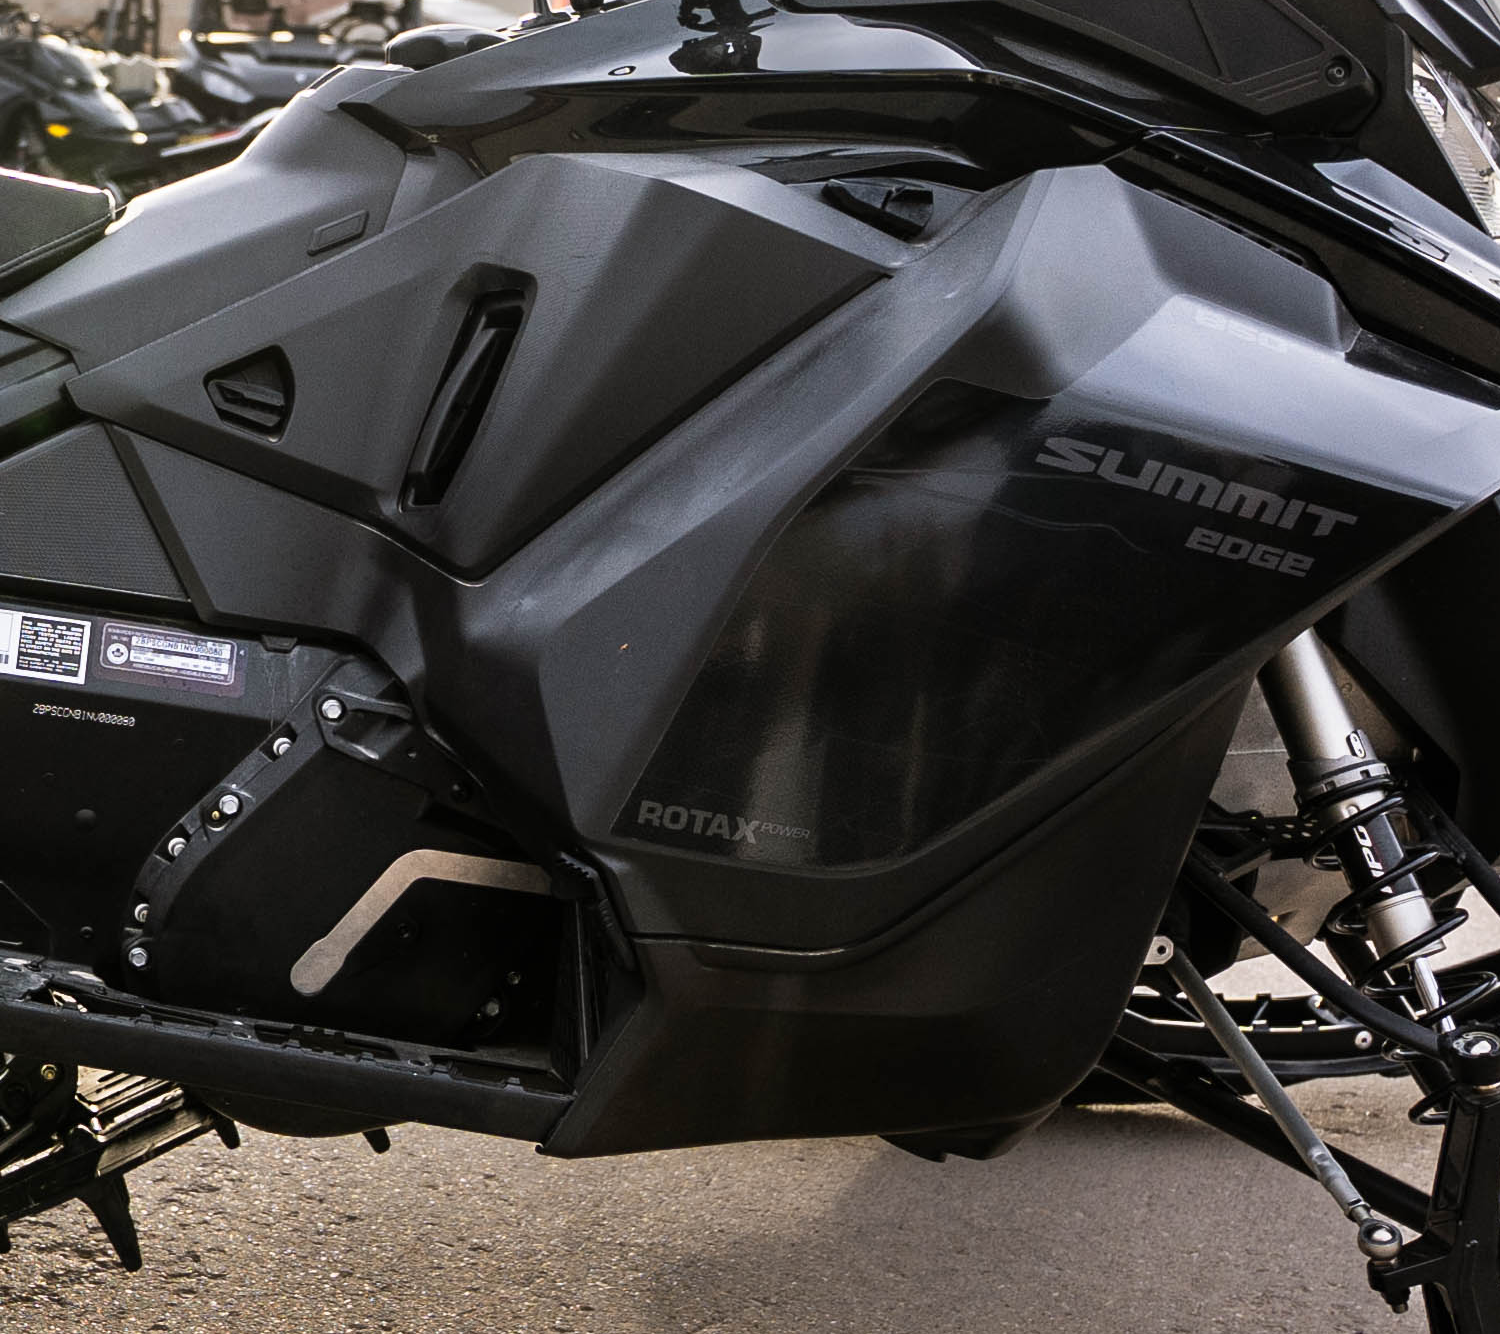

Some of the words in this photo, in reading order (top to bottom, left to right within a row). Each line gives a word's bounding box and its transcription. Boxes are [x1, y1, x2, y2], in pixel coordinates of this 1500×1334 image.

[1035, 437, 1358, 537] SUMMIT
[637, 800, 760, 844] ROTAX
[759, 820, 811, 840] POWER
